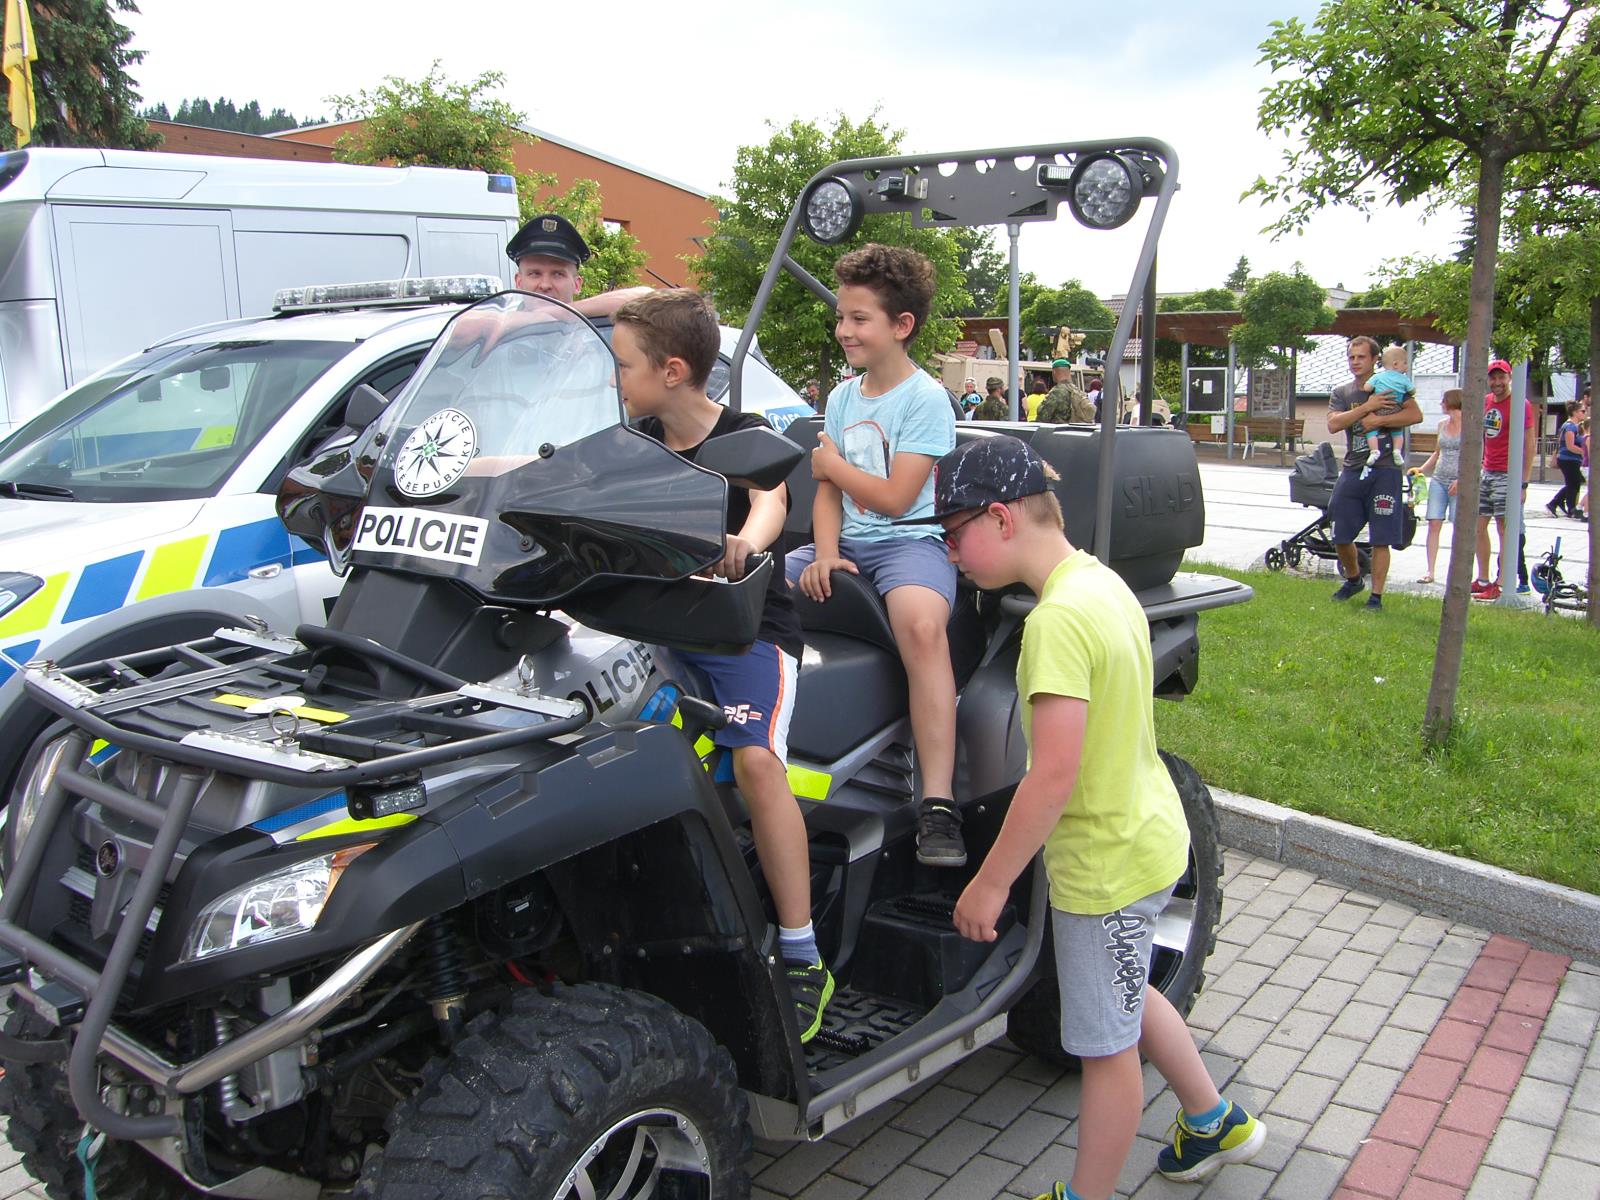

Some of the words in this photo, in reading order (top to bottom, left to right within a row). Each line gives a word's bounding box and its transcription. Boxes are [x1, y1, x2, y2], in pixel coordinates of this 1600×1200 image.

[423, 412, 471, 434] POLICIE
[405, 440, 472, 492] REPUBLIKY
[357, 513, 479, 558] POLICIE
[566, 643, 657, 723] OLICIE
